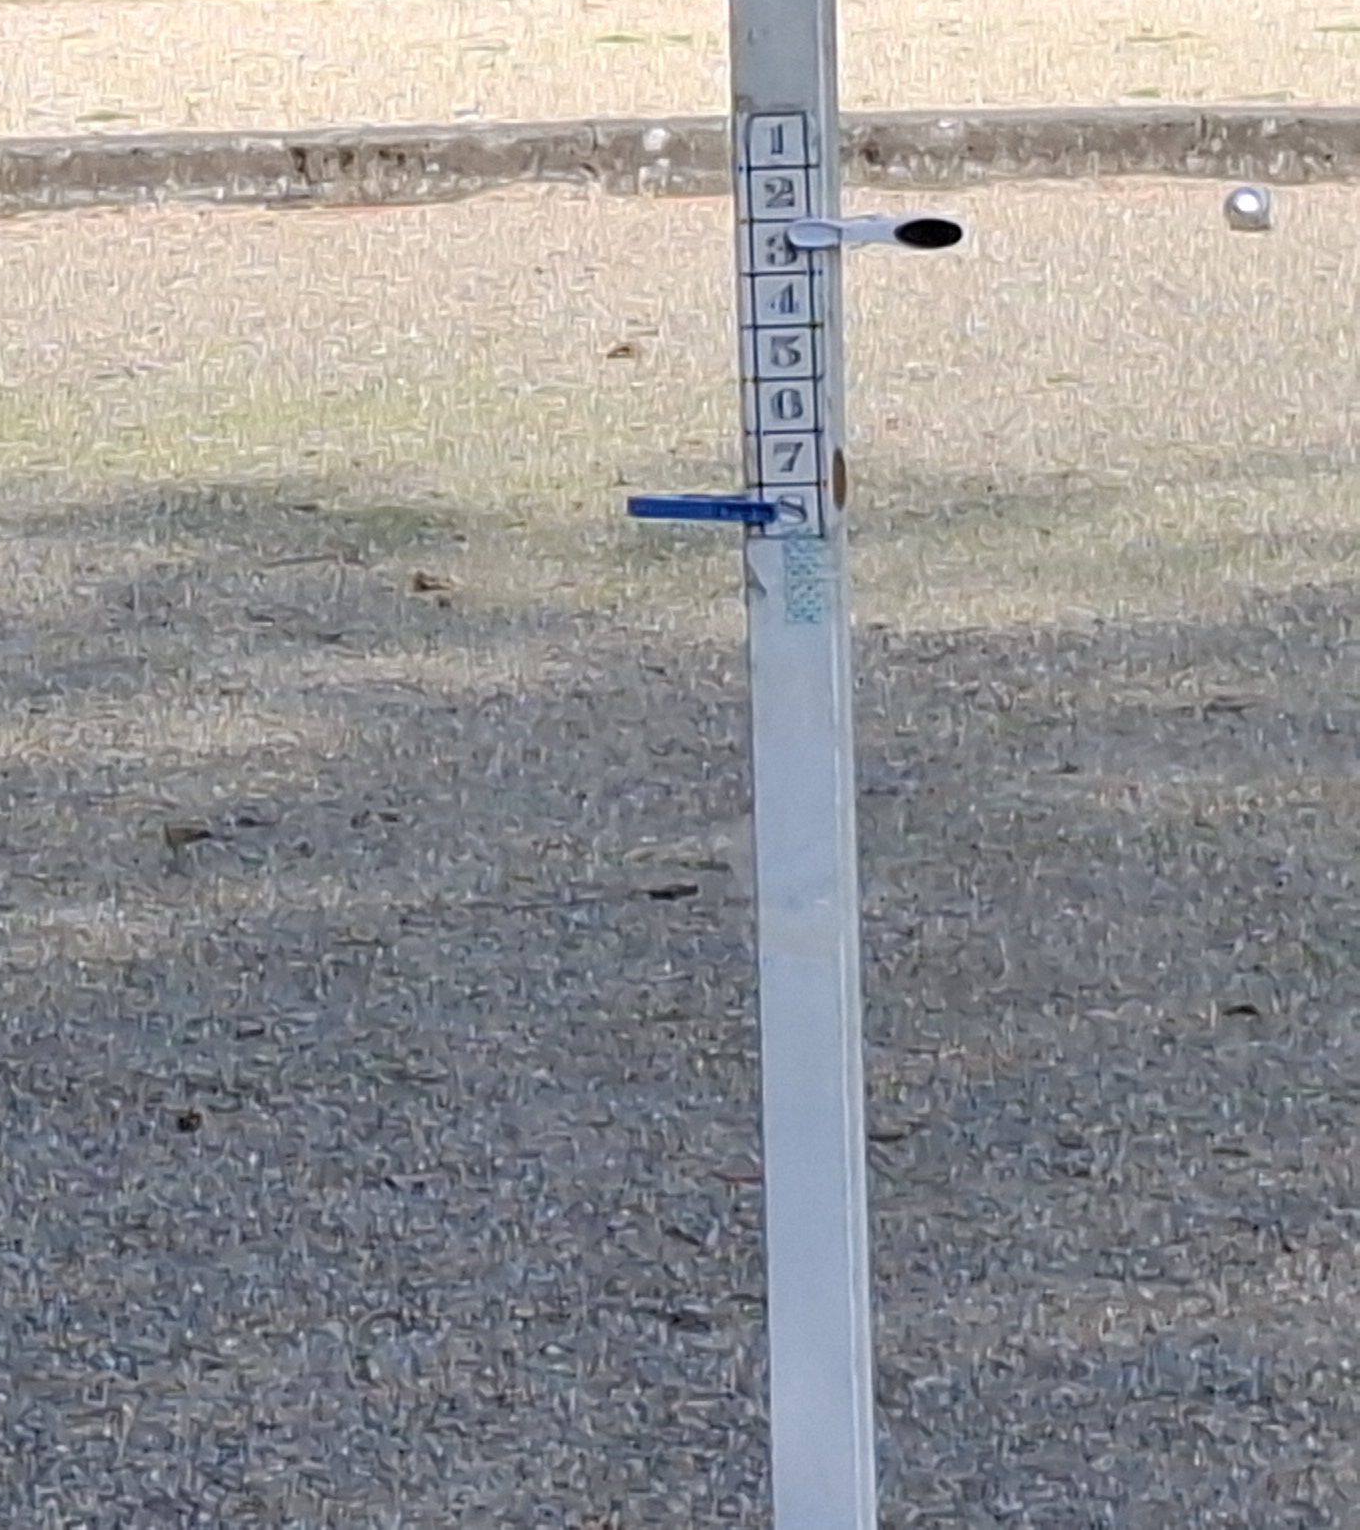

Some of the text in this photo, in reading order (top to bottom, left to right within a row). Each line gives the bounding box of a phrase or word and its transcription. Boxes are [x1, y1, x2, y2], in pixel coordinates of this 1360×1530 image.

[770, 124, 784, 155] 1
[764, 176, 796, 209] 2
[765, 230, 798, 267] 3
[766, 282, 801, 315] 4
[770, 335, 802, 369] 5
[770, 387, 804, 420] 6
[772, 441, 804, 473] 7
